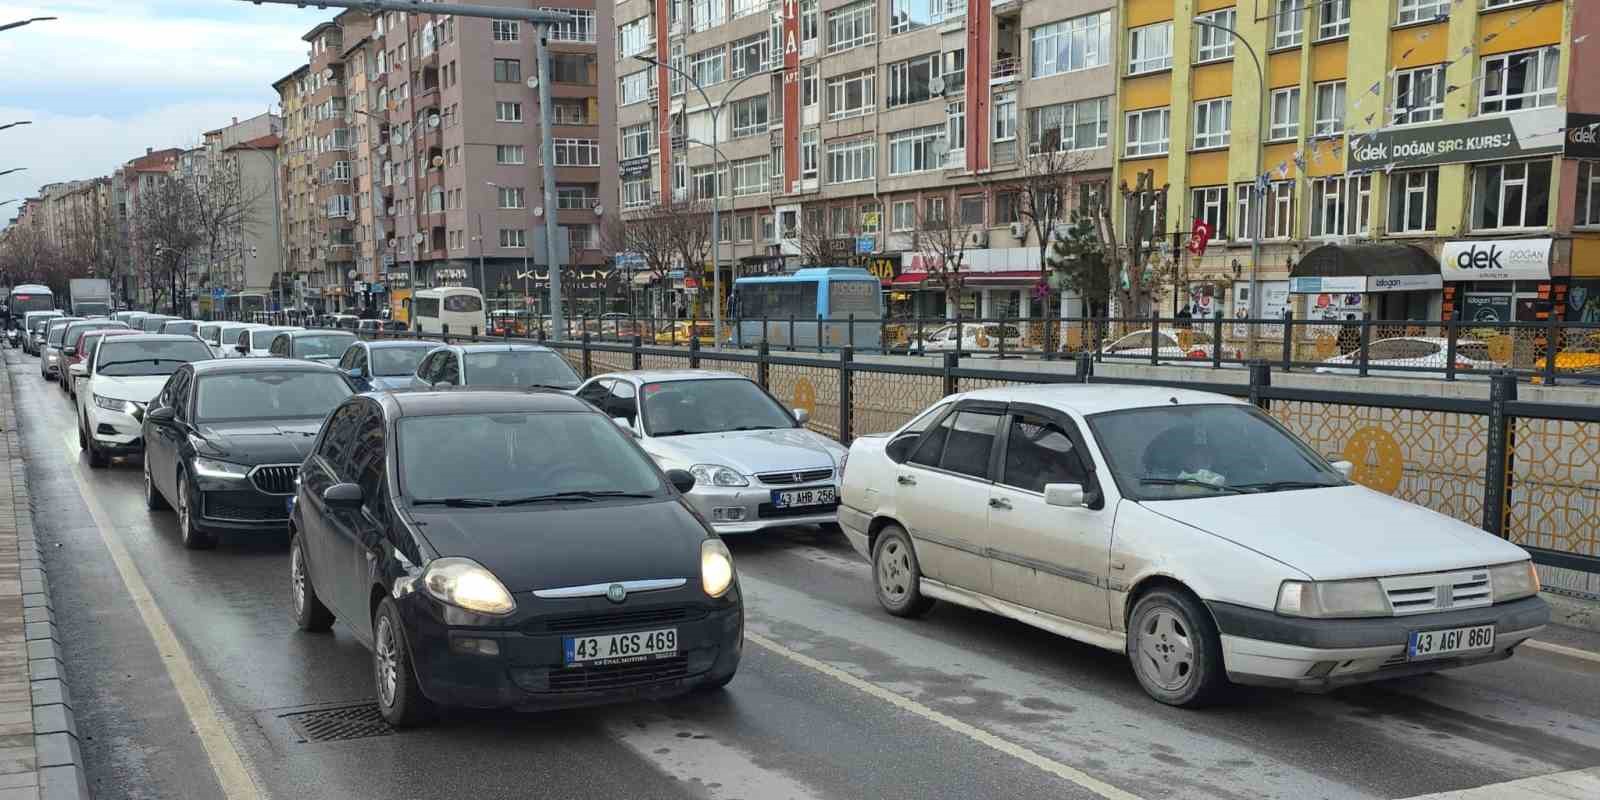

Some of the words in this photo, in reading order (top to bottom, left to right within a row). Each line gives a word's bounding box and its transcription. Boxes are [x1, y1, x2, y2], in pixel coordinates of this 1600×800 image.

[1361, 143, 1388, 161] dek
[1393, 140, 1435, 158] DOĞAN
[1438, 138, 1463, 153] SRC
[1466, 133, 1512, 151] KURSU
[1575, 127, 1597, 143] dek
[1457, 244, 1503, 269] dek
[577, 638, 598, 659] 43
[609, 634, 641, 656] AGS
[645, 630, 675, 652] 469
[1417, 634, 1433, 653] 43
[1468, 627, 1491, 647] 860
